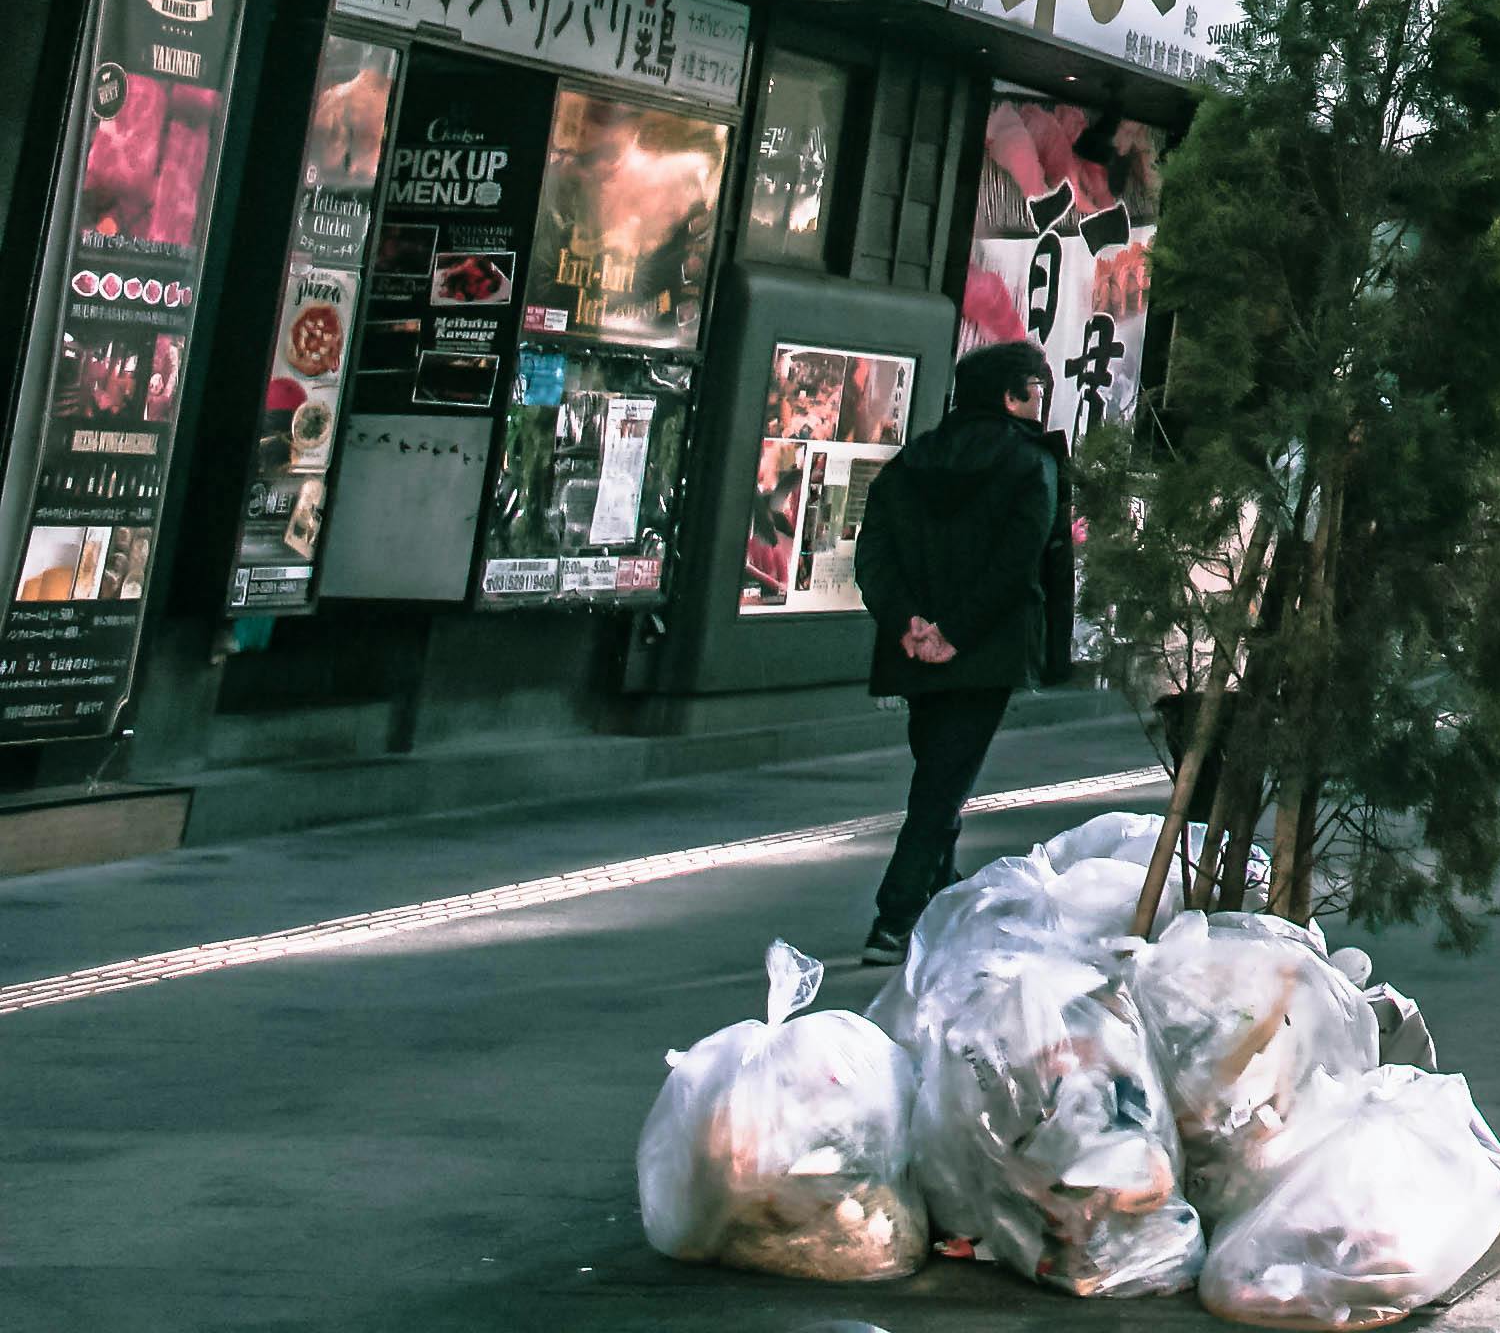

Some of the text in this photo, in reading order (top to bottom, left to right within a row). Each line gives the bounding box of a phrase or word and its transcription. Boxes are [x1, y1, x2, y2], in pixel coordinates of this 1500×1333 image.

[394, 151, 508, 183] PICK UP
[388, 180, 475, 206] MENU
